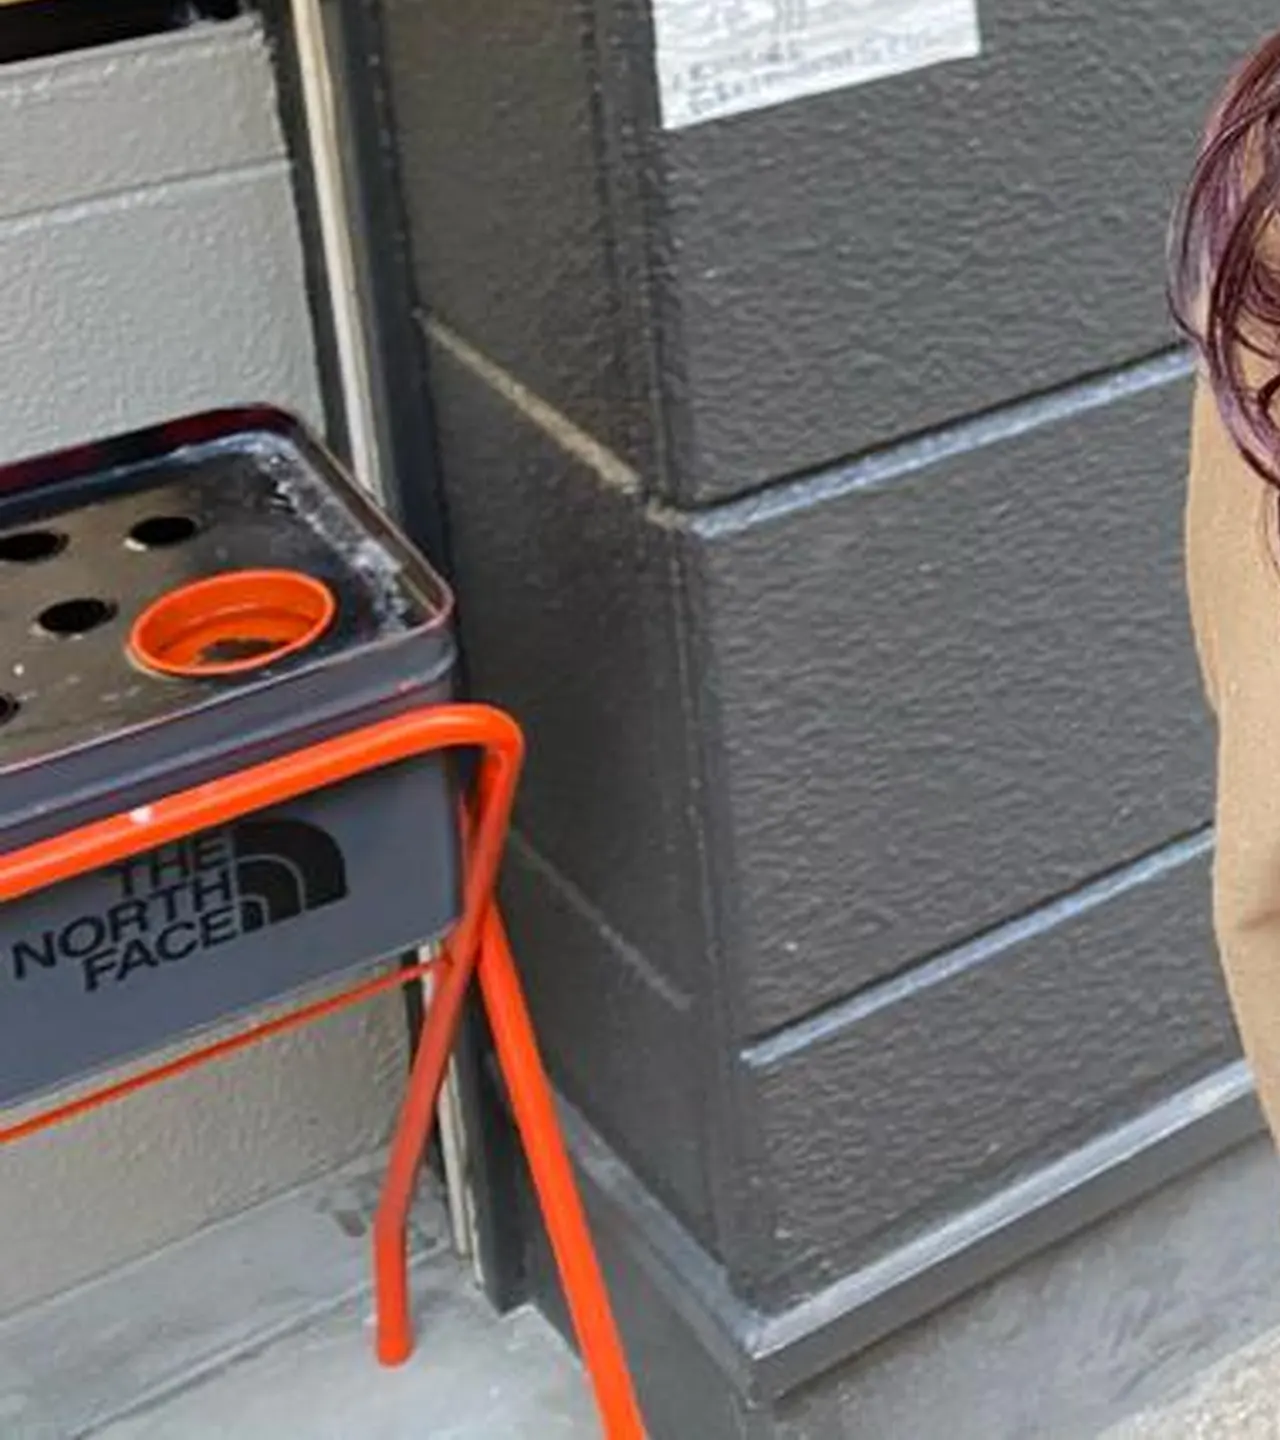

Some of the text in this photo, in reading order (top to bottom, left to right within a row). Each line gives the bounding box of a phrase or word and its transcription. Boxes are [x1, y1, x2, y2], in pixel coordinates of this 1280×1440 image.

[106, 828, 230, 896] THE
[11, 870, 233, 979] NORTH
[84, 905, 237, 992] FACE
